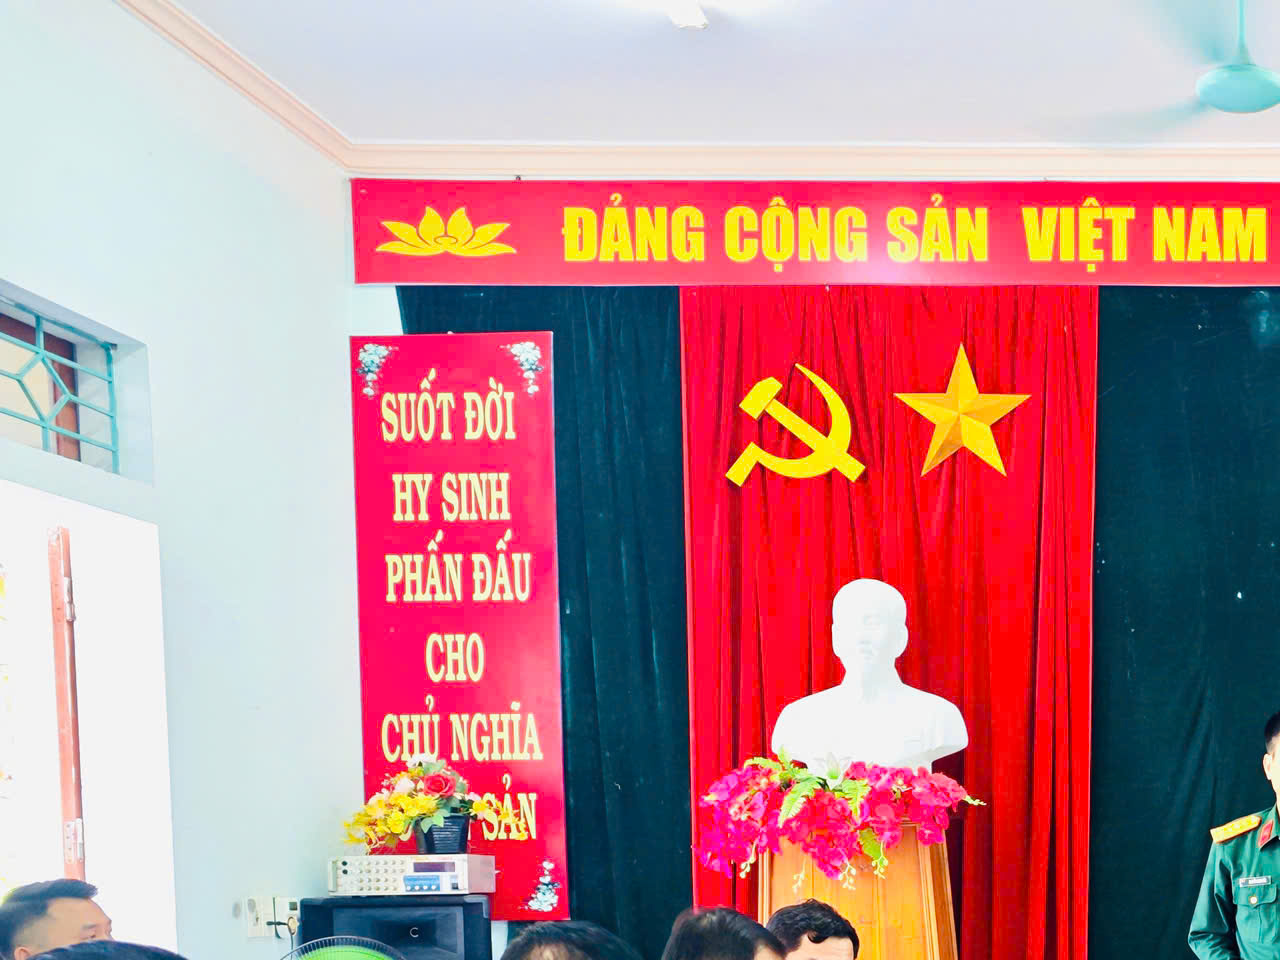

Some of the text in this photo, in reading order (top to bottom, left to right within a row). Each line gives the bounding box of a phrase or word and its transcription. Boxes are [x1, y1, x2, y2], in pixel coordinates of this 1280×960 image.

[562, 193, 705, 263] ĐẢNG
[724, 196, 866, 273] CỘNG
[885, 193, 989, 263] SẢN
[1021, 198, 1136, 273] VIỆT
[1153, 207, 1267, 262] NAM
[381, 367, 517, 442] SUỐT ĐỜI
[391, 472, 511, 522] HY SINH
[385, 528, 532, 603] PHẤN ĐẤU
[425, 632, 485, 683] CHO
[381, 694, 544, 763] CHỦ NGHĨA
[481, 773, 537, 841] SẢN
